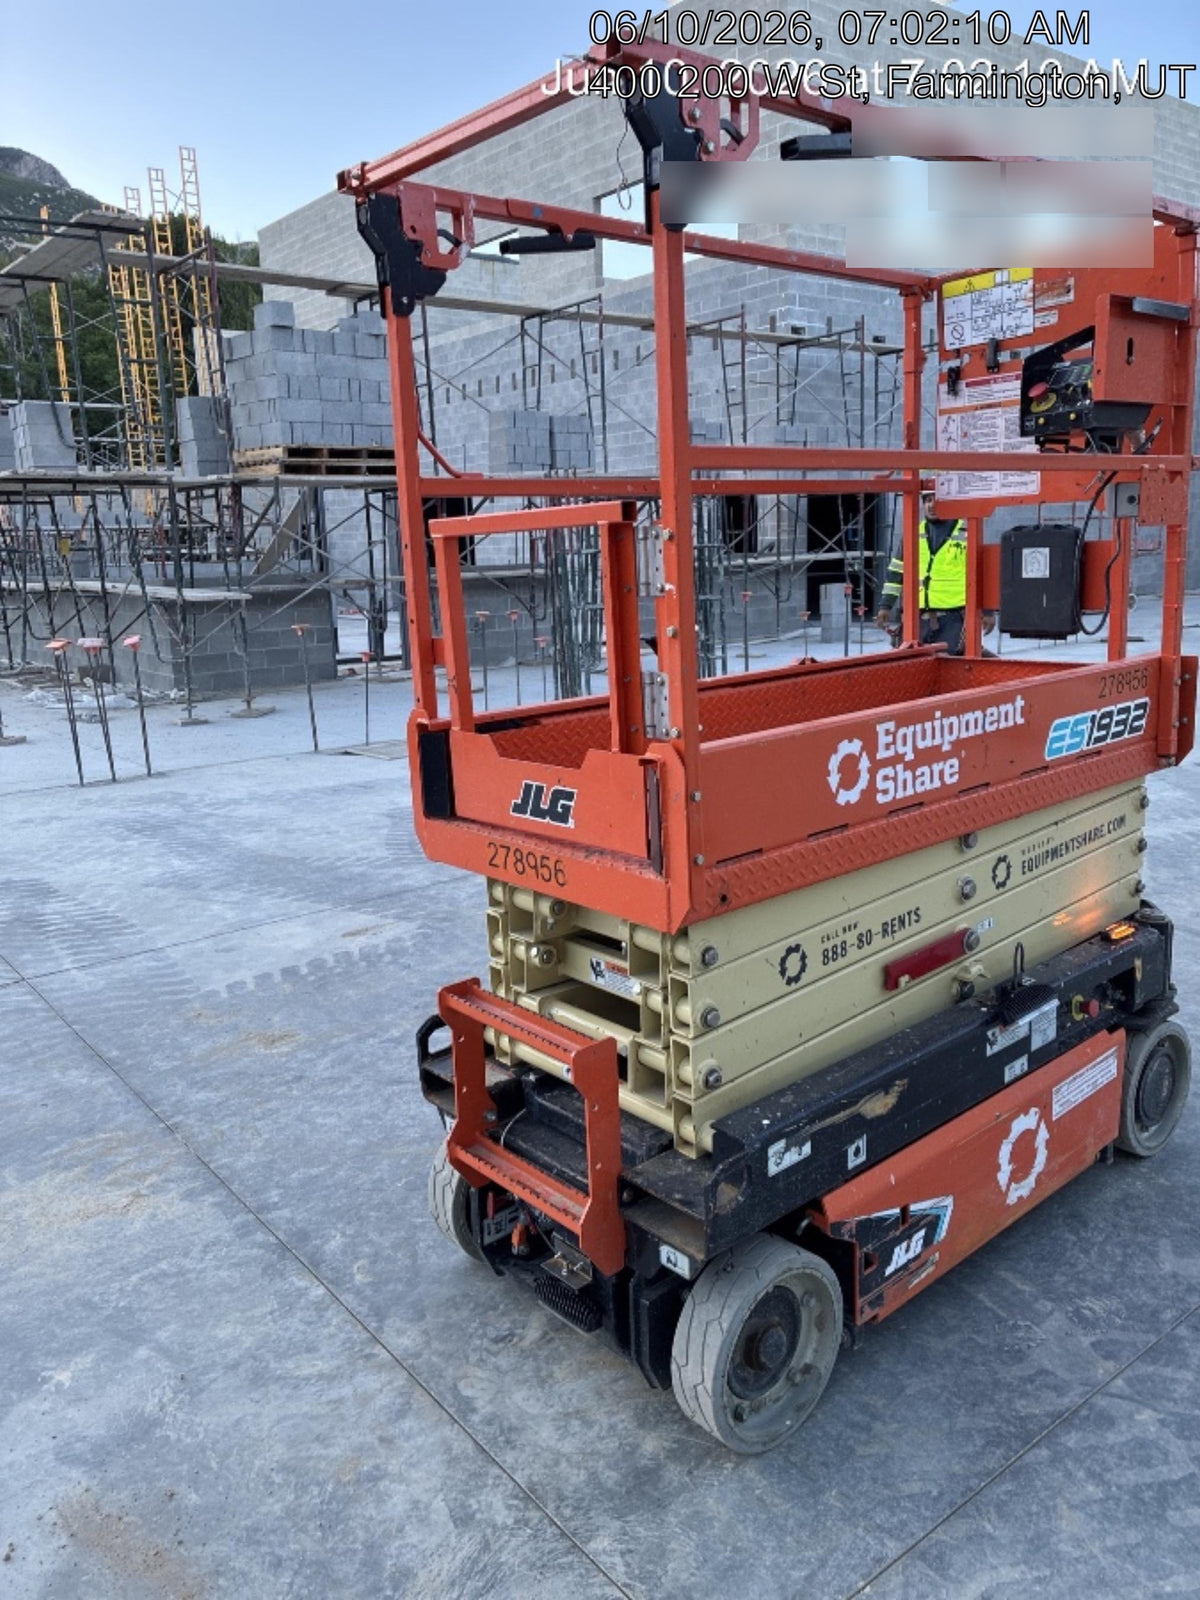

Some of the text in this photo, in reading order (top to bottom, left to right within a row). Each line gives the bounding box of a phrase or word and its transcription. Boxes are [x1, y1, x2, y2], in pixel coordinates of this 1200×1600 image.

[1098, 667, 1149, 699] 278956
[876, 695, 1025, 762] Equipment
[1045, 697, 1150, 761] ES1932
[510, 780, 577, 829] JLG
[876, 757, 960, 804] Share
[487, 841, 567, 887] 278956
[1021, 813, 1127, 876] EQUIPMENTSHARE.COM
[822, 907, 922, 966] 888-80-RENTS
